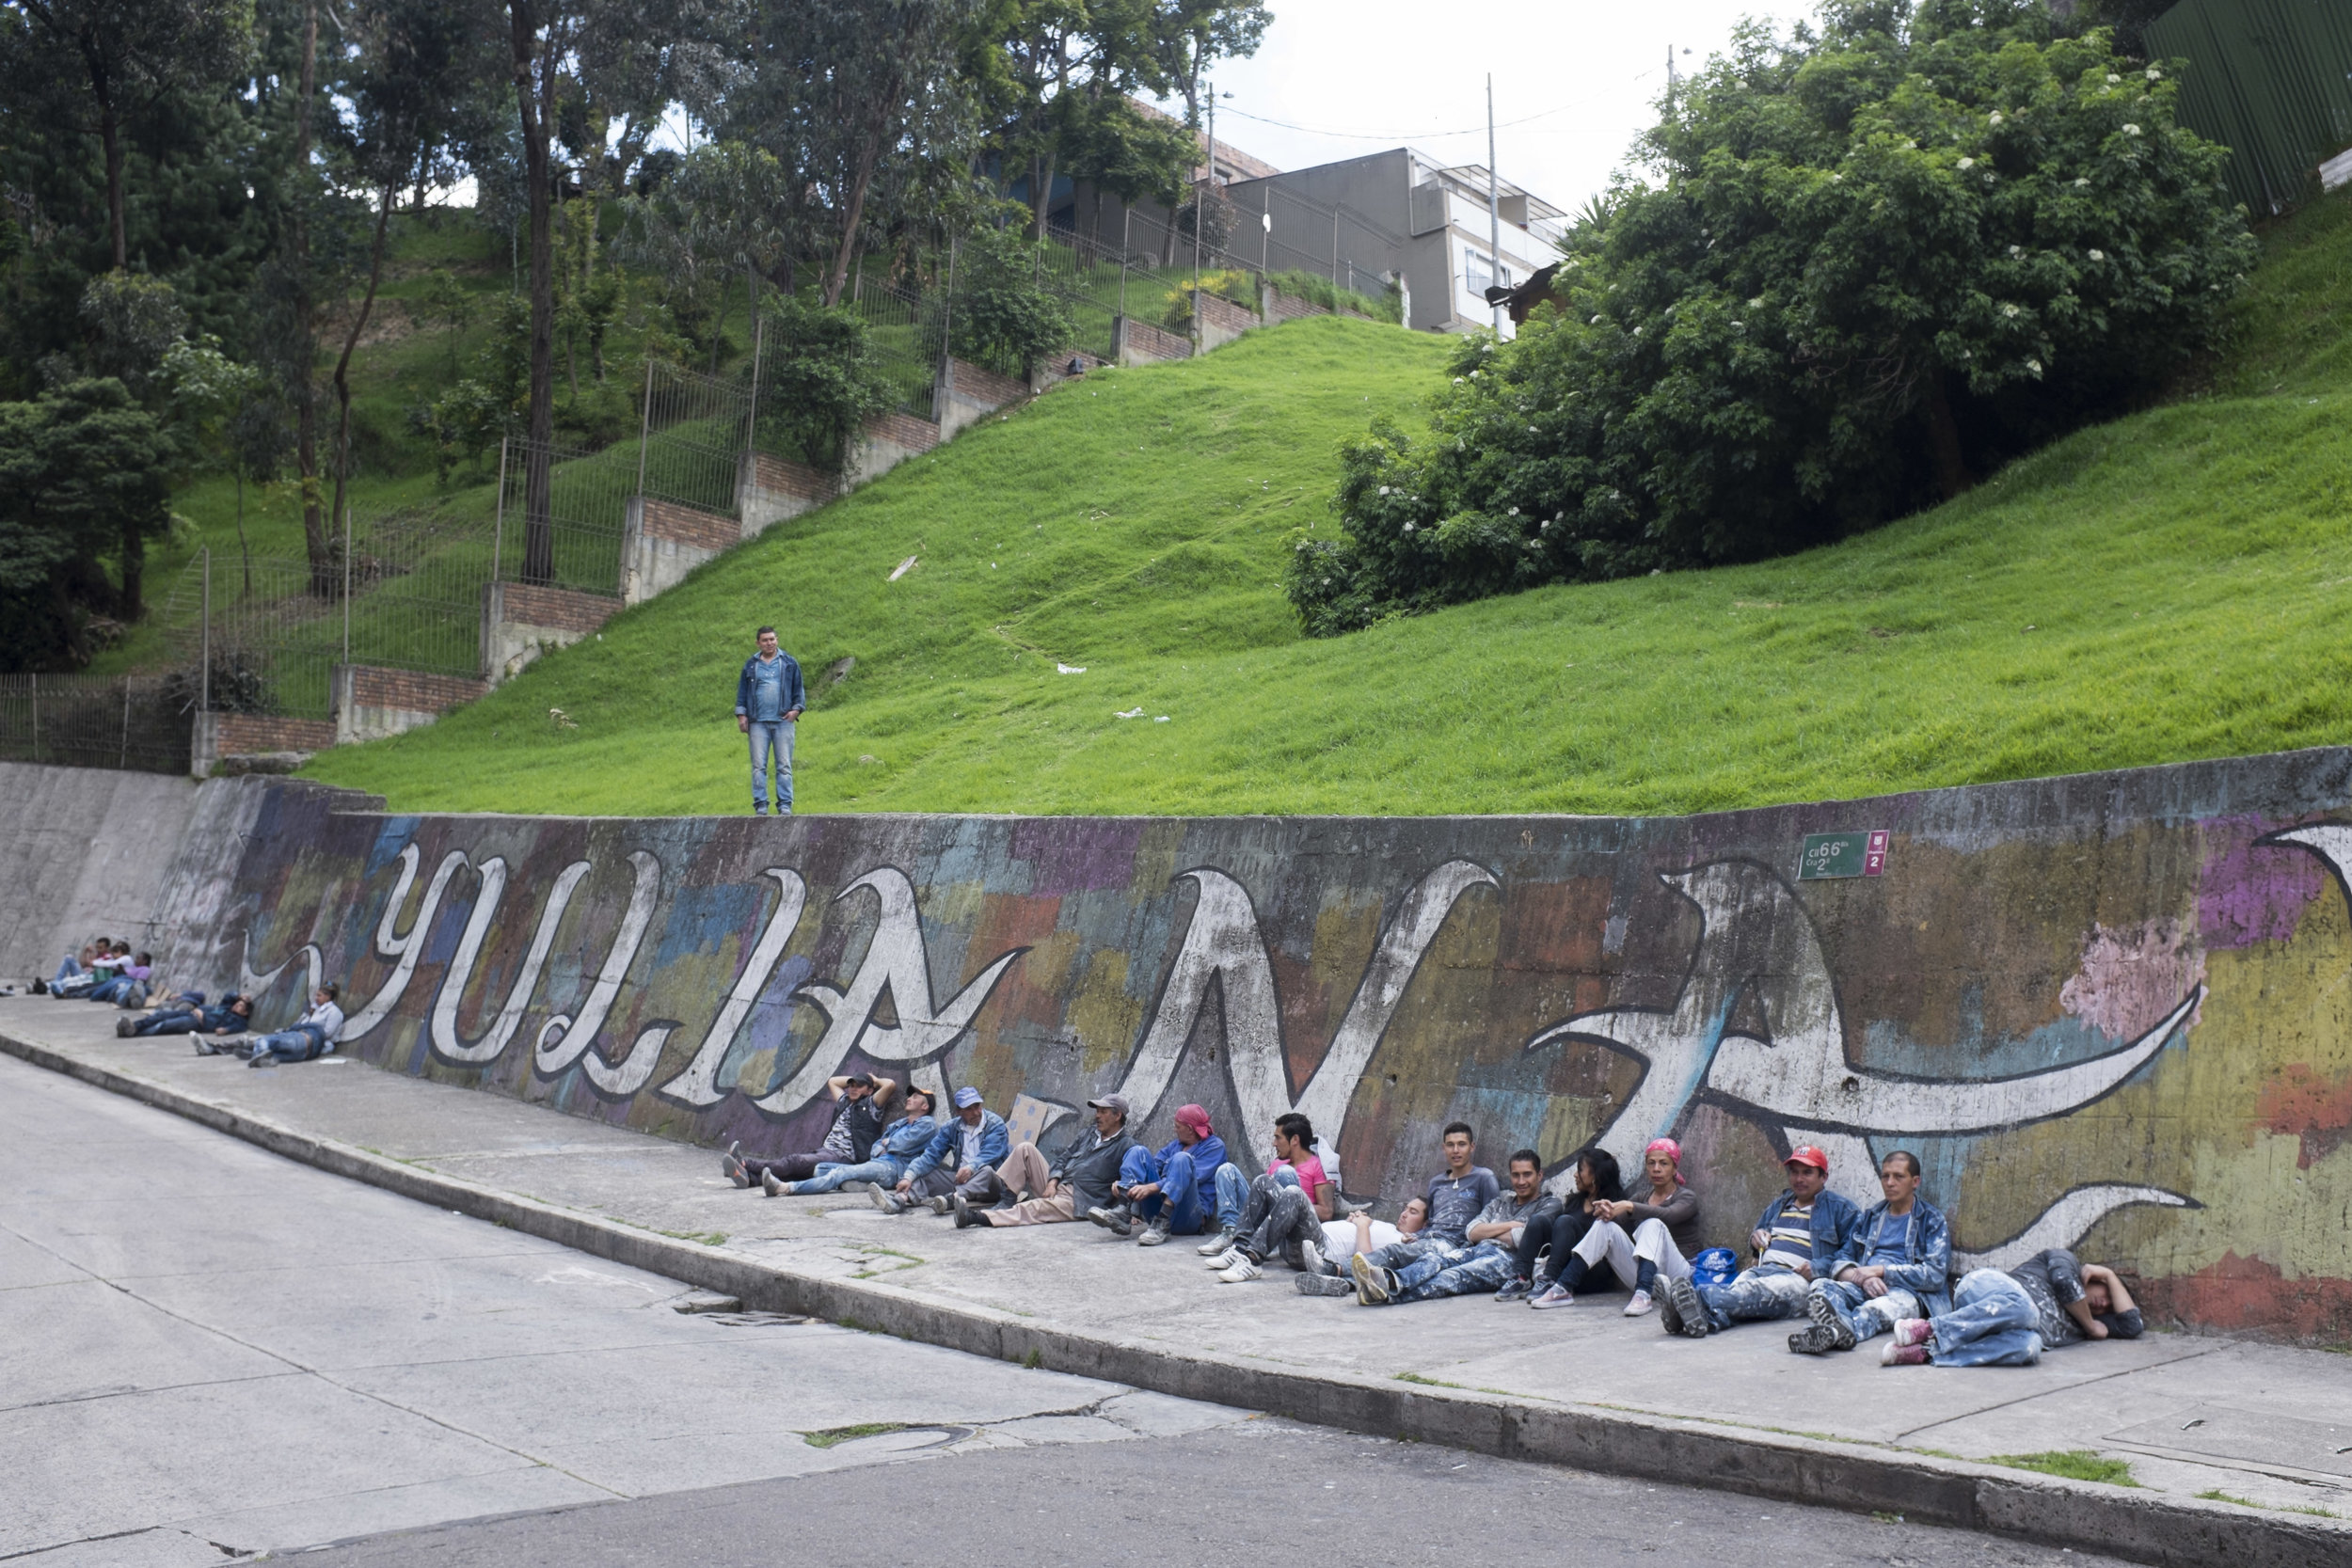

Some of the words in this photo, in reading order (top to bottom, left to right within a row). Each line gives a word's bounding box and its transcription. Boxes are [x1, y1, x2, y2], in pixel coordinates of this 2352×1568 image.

[1820, 842, 1840, 857] 66
[1817, 858, 1825, 870] 2
[1870, 856, 1879, 866] 2
